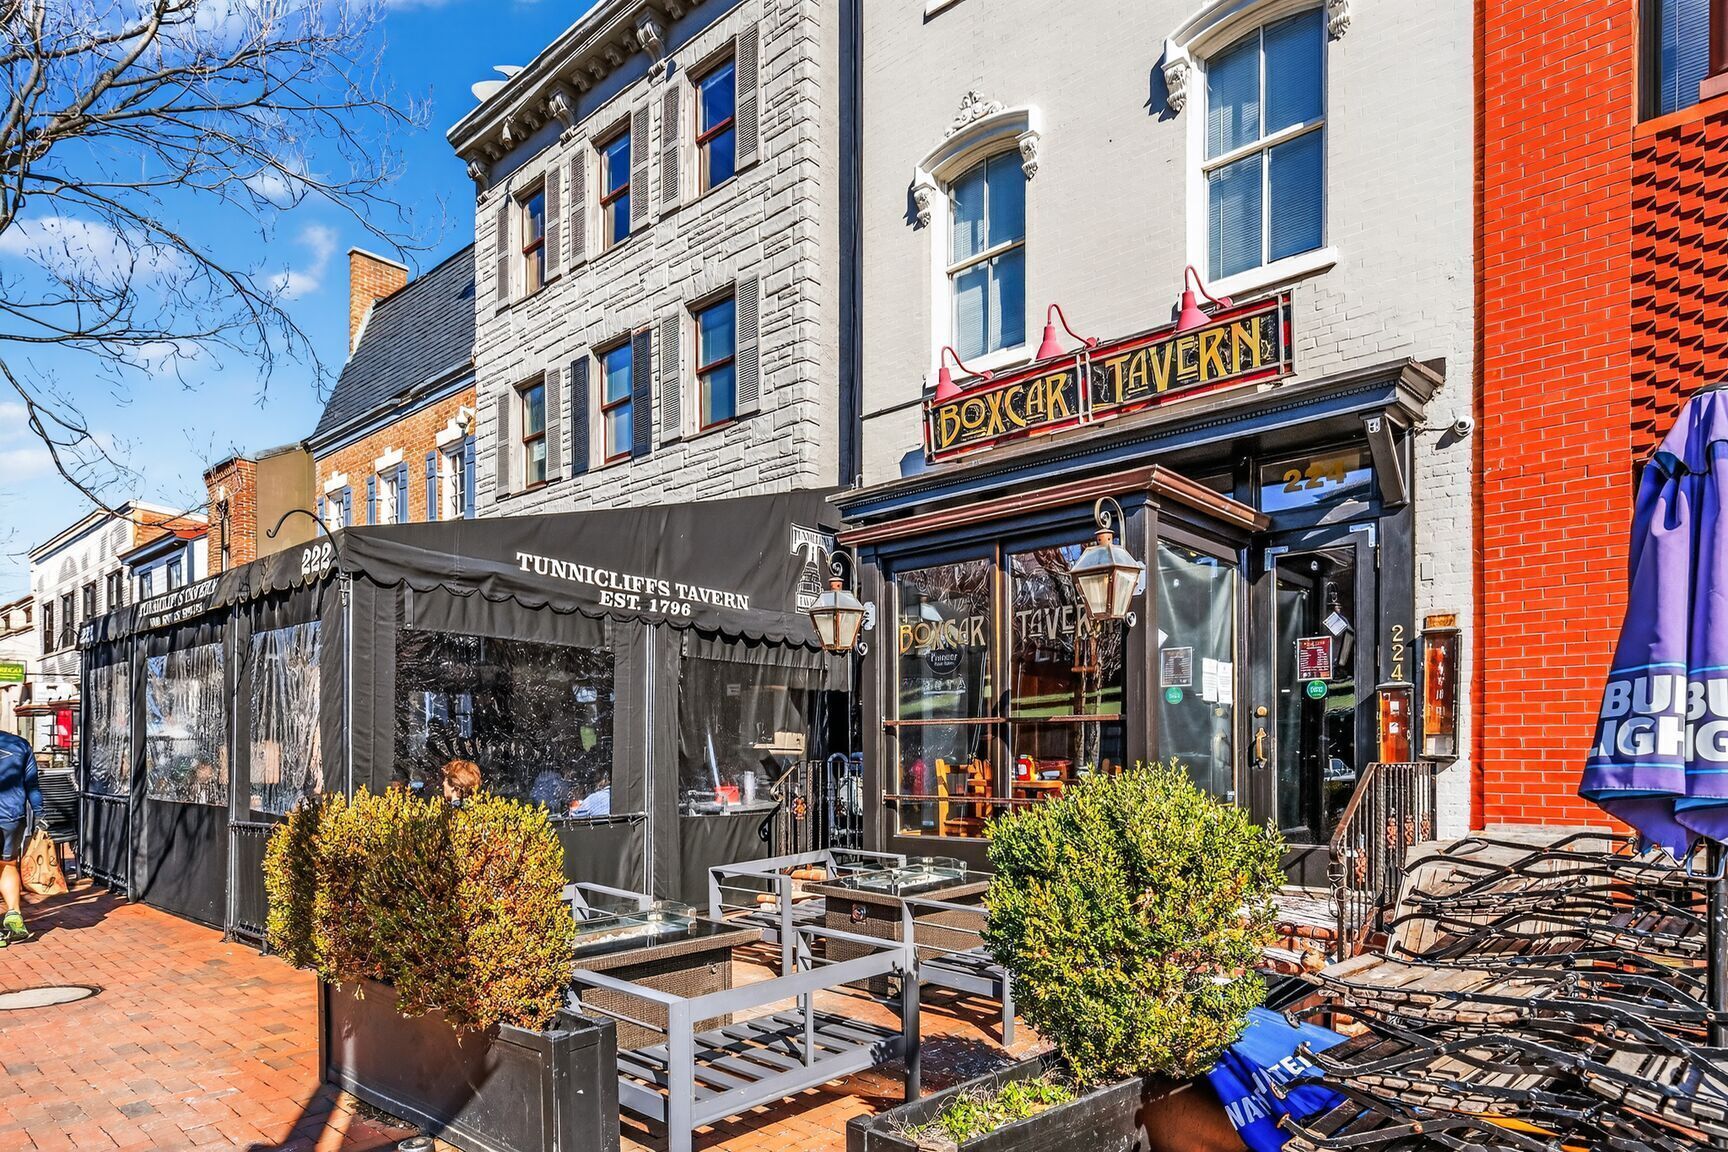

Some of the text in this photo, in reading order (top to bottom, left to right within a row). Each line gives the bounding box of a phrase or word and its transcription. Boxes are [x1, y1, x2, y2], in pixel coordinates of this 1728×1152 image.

[938, 316, 1261, 449] BOXCAR TAVERN
[1283, 461, 1347, 493] 224
[302, 541, 332, 576] 222
[516, 551, 750, 611] TUNNICLIFFS TAVERN
[599, 591, 691, 617] EST. 1796
[900, 615, 987, 653] BOXCAR
[1390, 624, 1405, 681] 224
[1590, 716, 1686, 757] IGH
